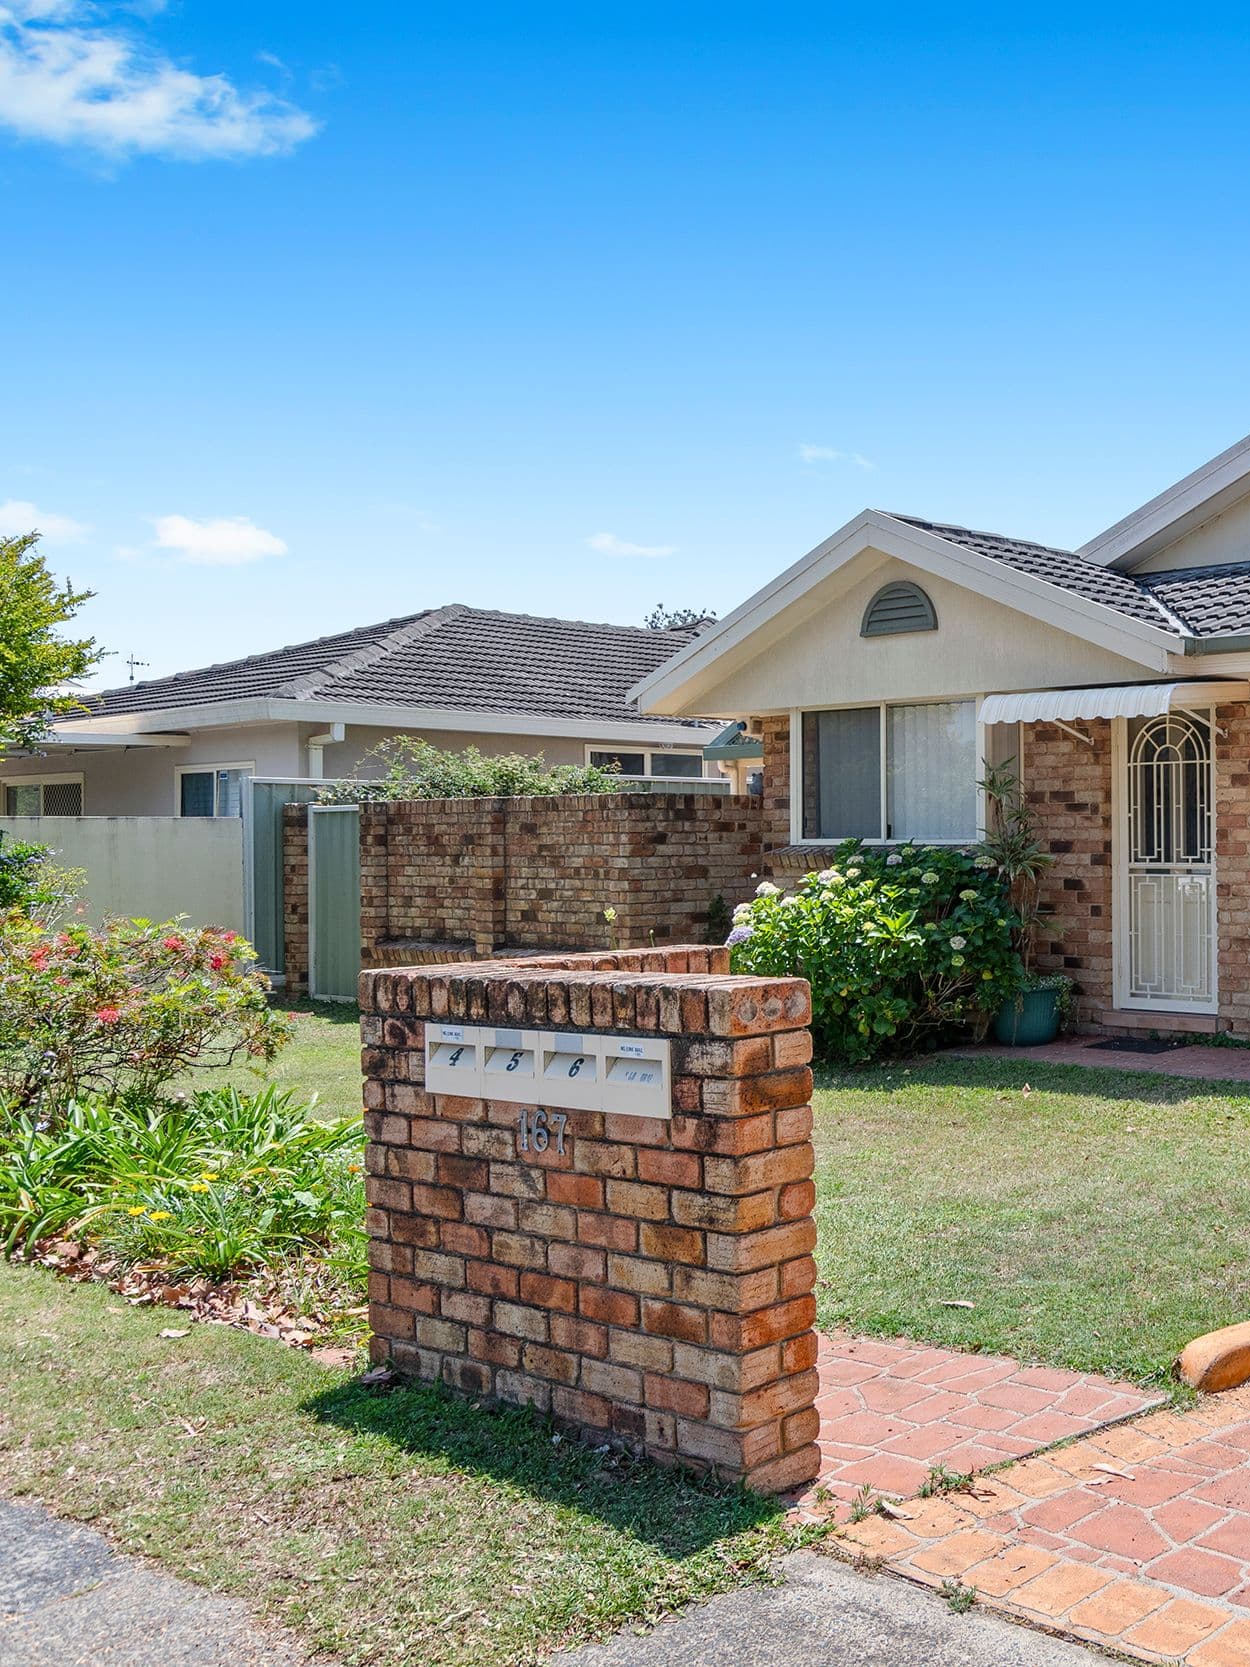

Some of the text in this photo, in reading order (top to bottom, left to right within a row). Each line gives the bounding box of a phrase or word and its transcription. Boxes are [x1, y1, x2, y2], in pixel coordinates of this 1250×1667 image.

[449, 1047, 464, 1066] 4
[506, 1052, 524, 1071] 5
[568, 1057, 585, 1078] 6
[519, 1109, 568, 1156] 167
